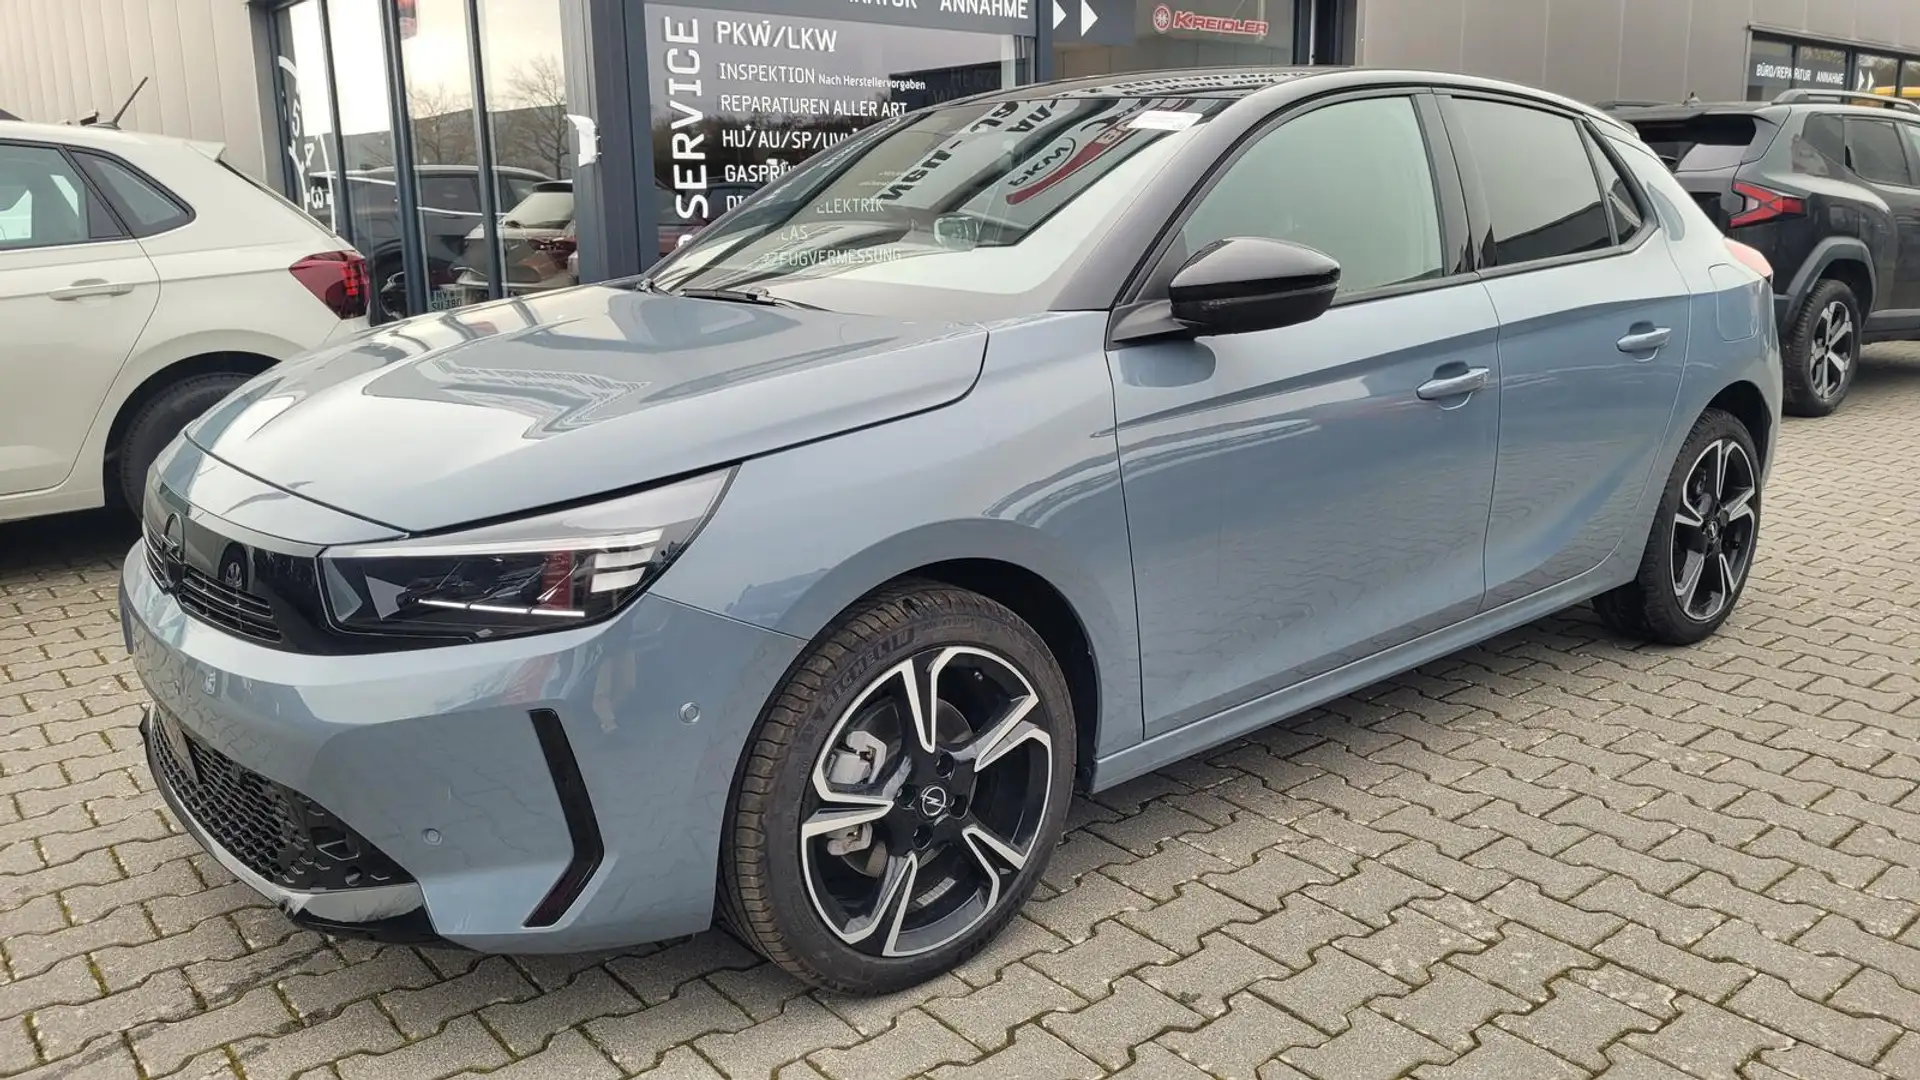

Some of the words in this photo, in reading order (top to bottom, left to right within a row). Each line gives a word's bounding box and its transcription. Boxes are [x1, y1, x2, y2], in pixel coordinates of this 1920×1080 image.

[940, 0, 1028, 19] ANNAHME
[1173, 11, 1268, 35] KREIDLER
[717, 20, 837, 52] PKW/LKW
[719, 62, 815, 84] INSPEKTION
[818, 74, 841, 86] Nach
[843, 76, 926, 91] Herstellervorgaben
[664, 16, 708, 218] SERVICE
[721, 95, 830, 115] REPARATUREN
[833, 101, 878, 116] ALLER
[881, 102, 908, 117] ART
[722, 129, 849, 149] HU/AU/SP/UV
